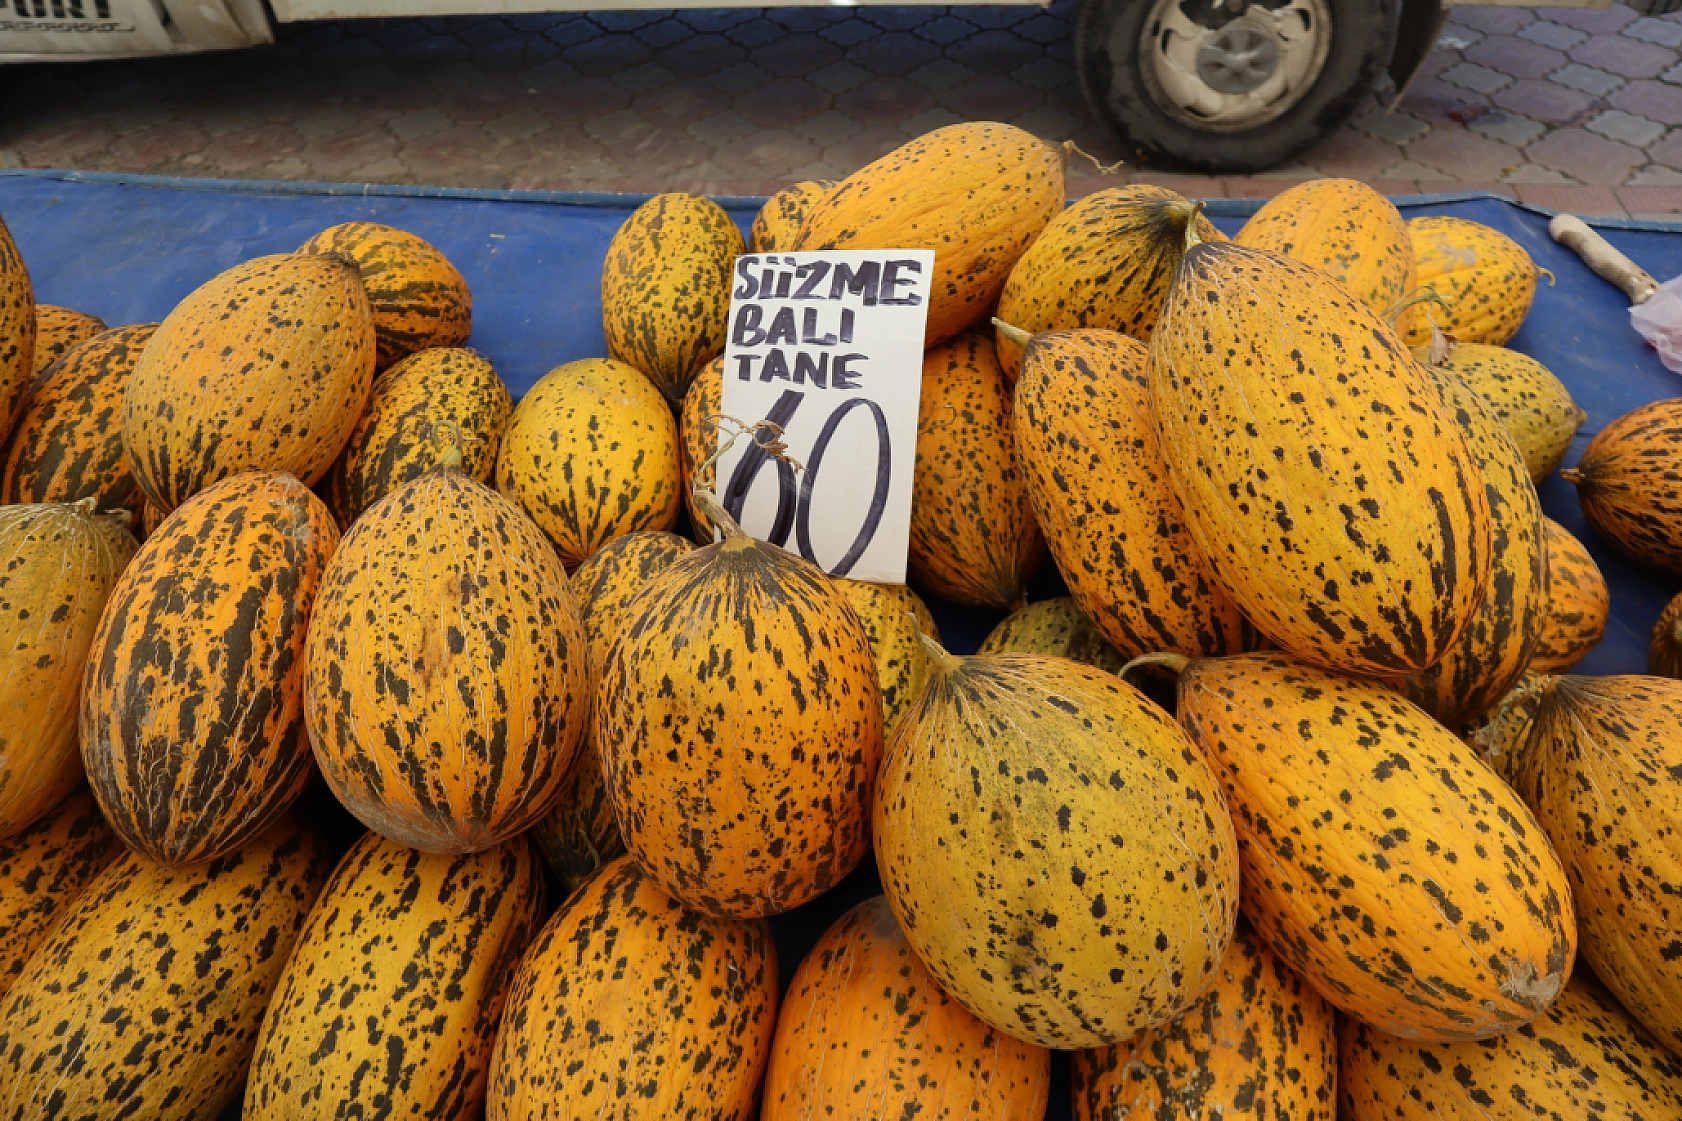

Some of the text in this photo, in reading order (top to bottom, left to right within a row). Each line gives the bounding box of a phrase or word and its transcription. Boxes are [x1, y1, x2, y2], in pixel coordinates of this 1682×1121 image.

[732, 304, 855, 346] BALI
[733, 348, 868, 389] TANE
[723, 389, 891, 577] 60
